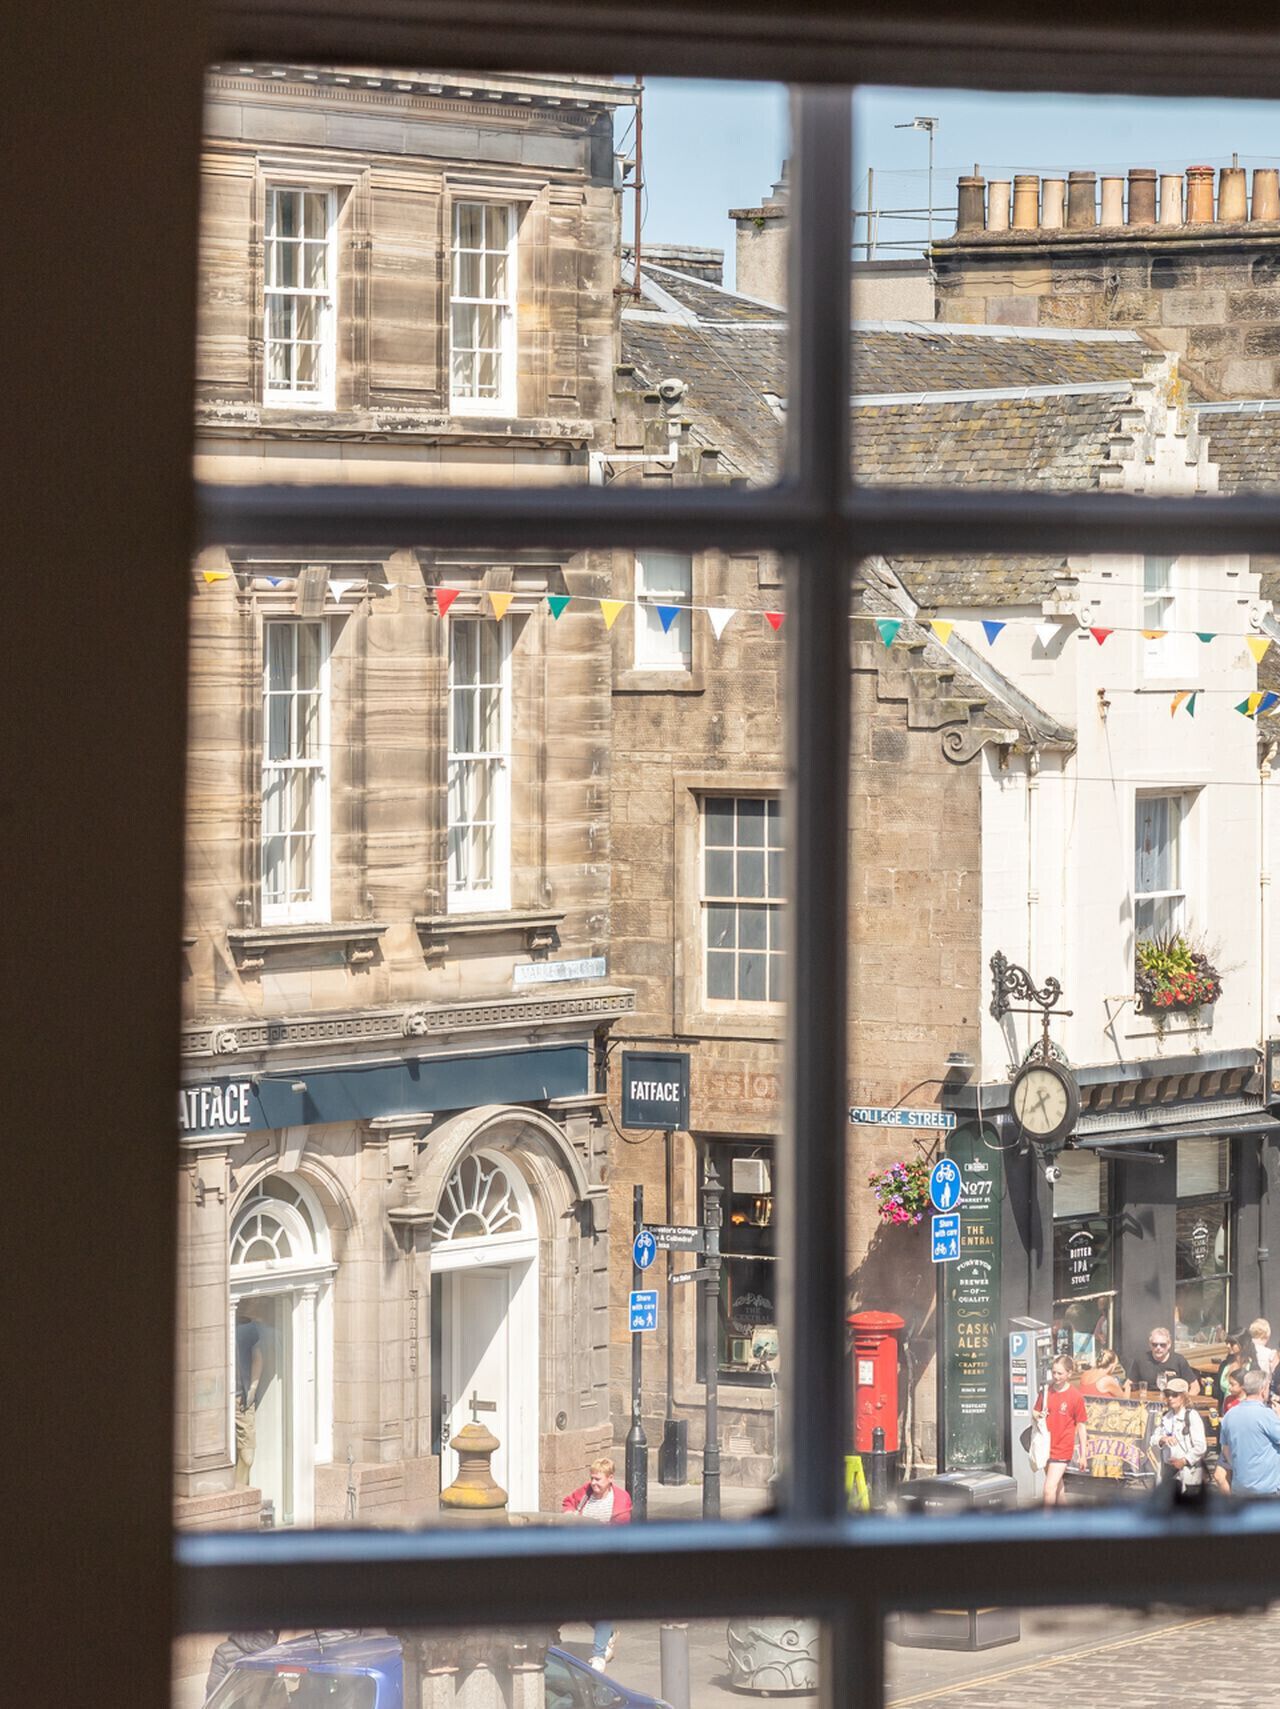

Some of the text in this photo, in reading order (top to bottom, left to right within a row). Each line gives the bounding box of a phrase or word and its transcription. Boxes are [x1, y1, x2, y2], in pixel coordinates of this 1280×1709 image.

[630, 1080, 680, 1102] FATFACE
[179, 1083, 252, 1129] ATFACE
[852, 1109, 953, 1127] COLLEGE STREET
[677, 1227, 699, 1236] College
[966, 1225, 985, 1235] THE
[960, 1236, 995, 1246] ENTRAL
[1073, 1260, 1088, 1273] IPA
[959, 1278, 989, 1286] BREWER
[1071, 1274, 1090, 1285] STOUT
[957, 1323, 989, 1335] CASK
[958, 1336, 989, 1348] ALES
[1013, 1335, 1024, 1353] P
